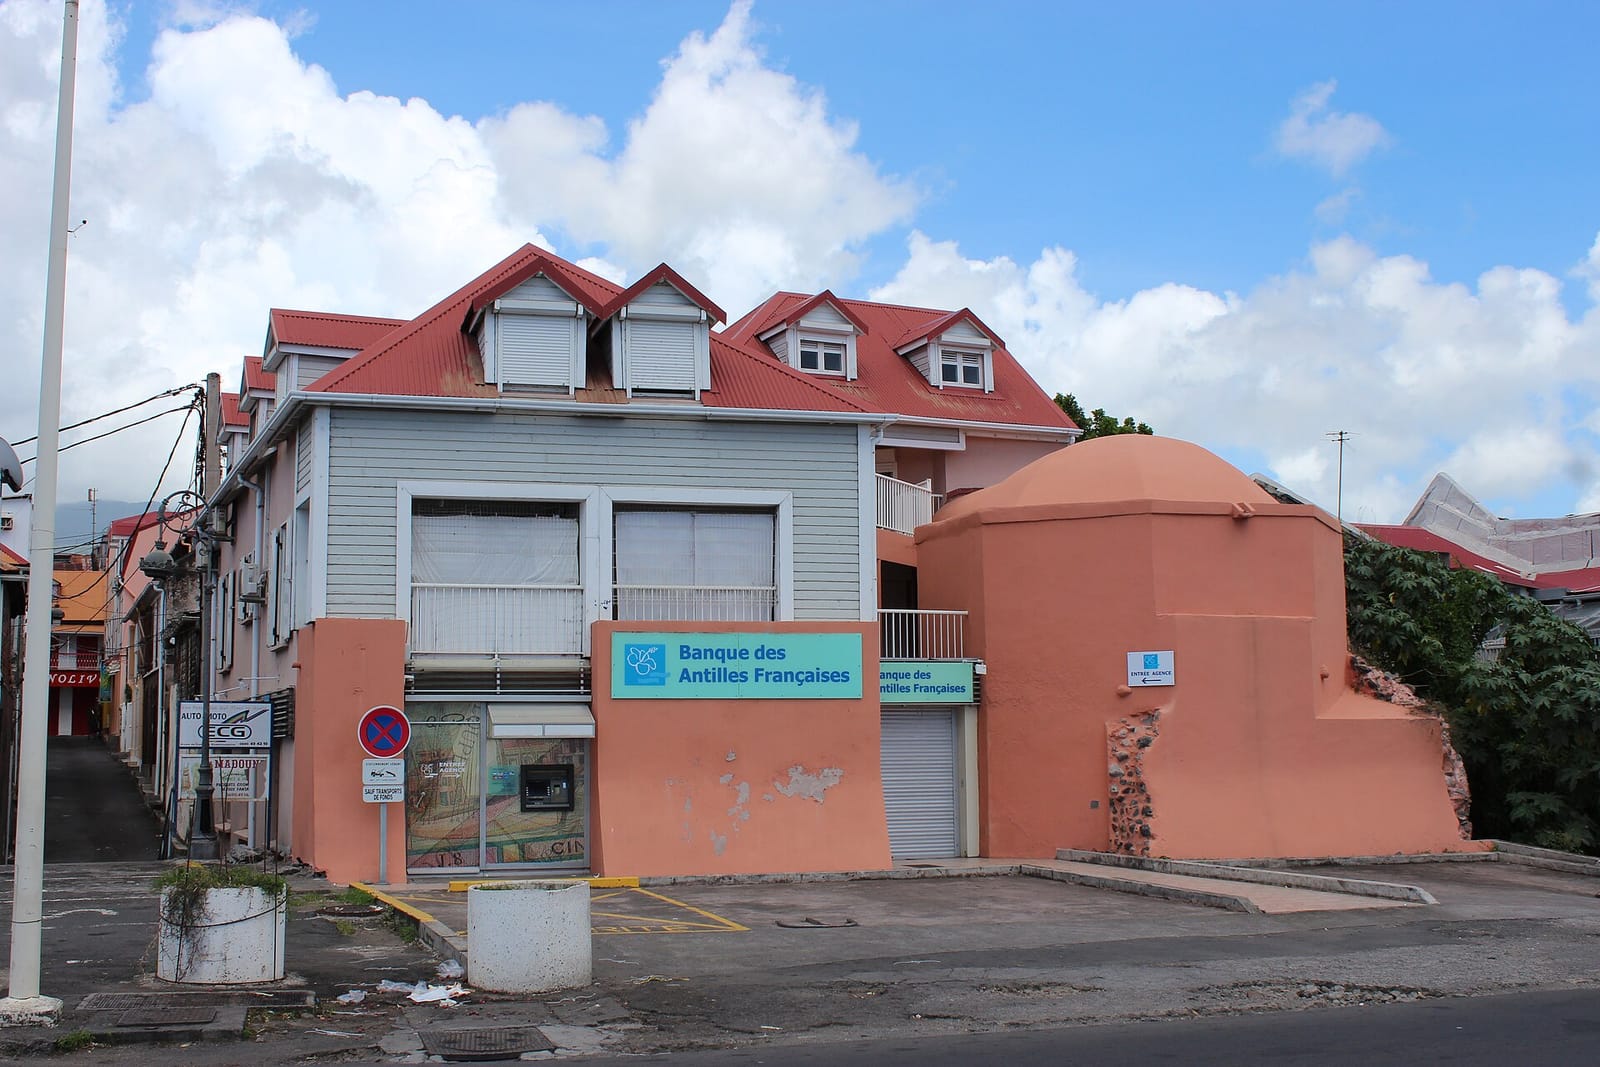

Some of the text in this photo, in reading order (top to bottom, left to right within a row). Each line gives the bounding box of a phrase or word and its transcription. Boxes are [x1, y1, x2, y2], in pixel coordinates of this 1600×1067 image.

[679, 644, 786, 663] Banque des
[49, 674, 101, 684] NOLIV
[679, 667, 850, 686] Antilles Françaises
[914, 670, 931, 679] des
[914, 683, 966, 695] Françaises
[181, 712, 202, 720] AUTO
[209, 726, 246, 737] ECG
